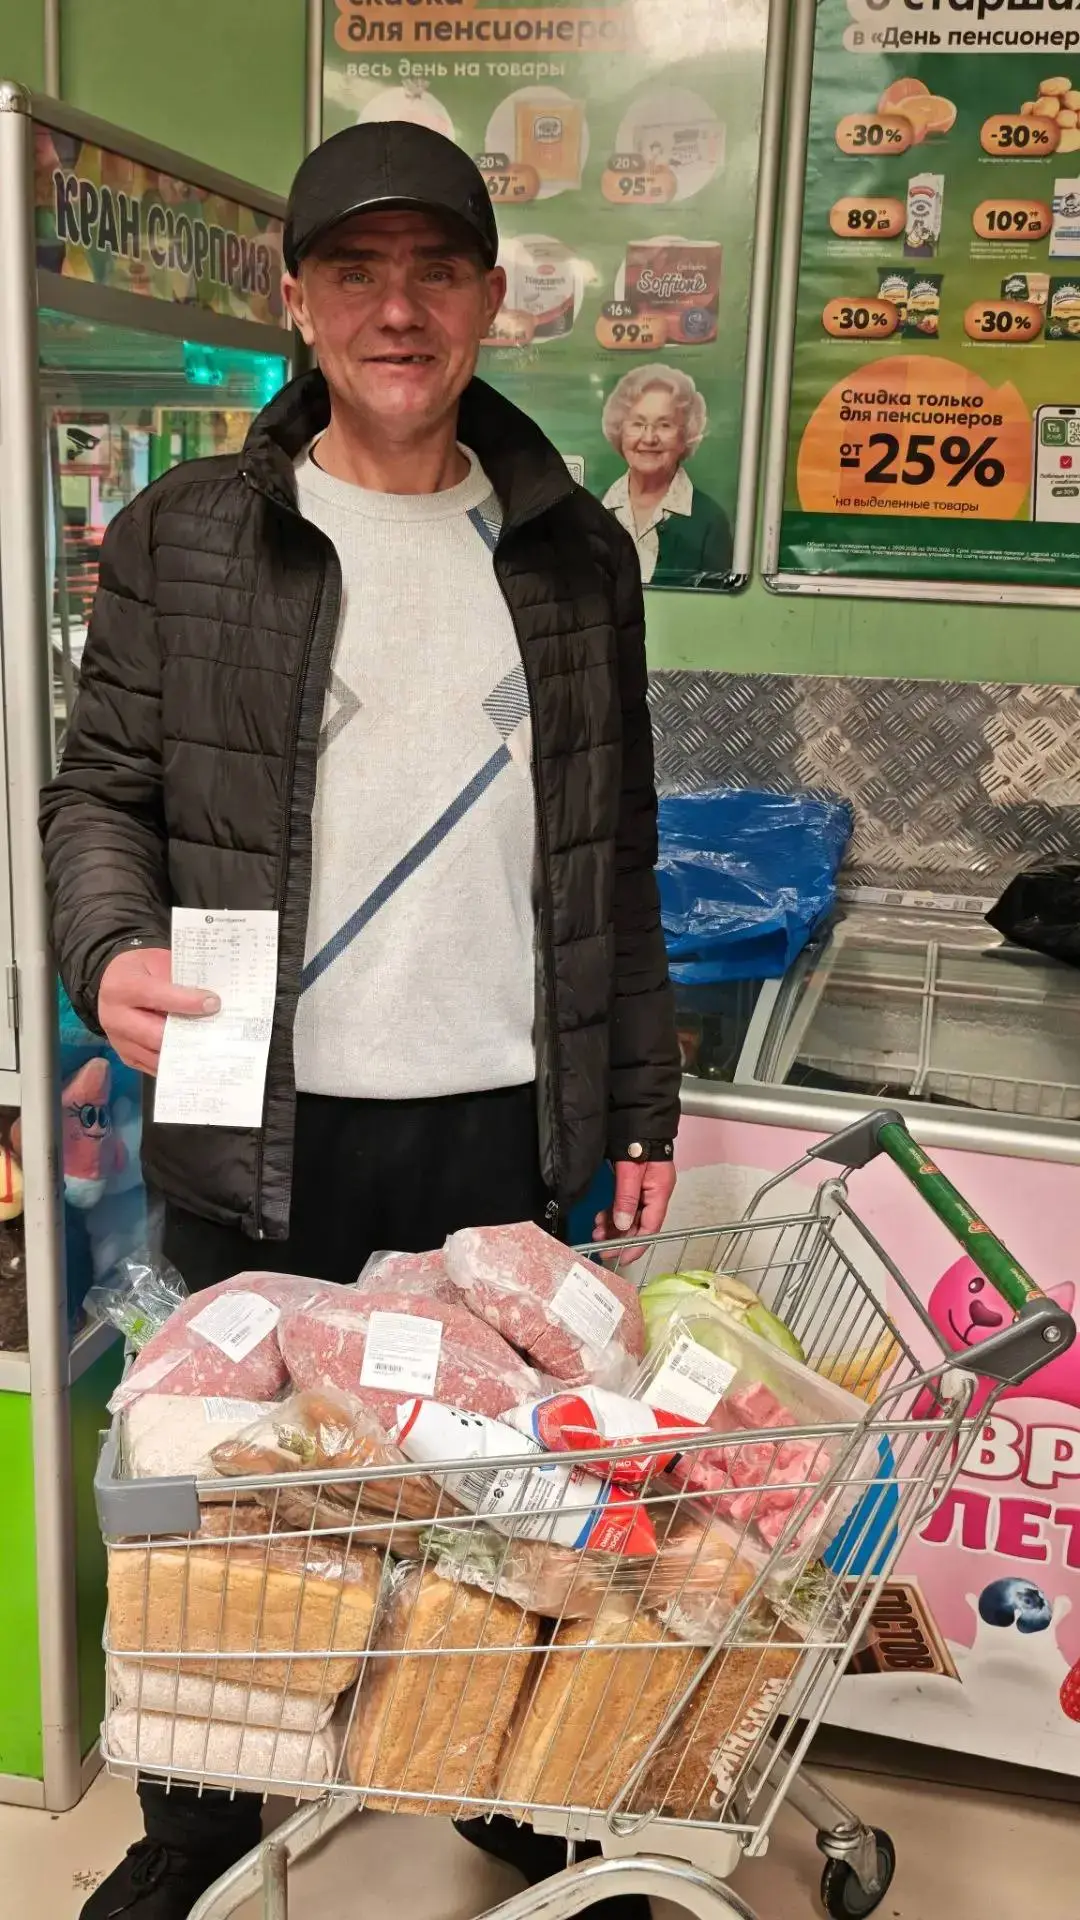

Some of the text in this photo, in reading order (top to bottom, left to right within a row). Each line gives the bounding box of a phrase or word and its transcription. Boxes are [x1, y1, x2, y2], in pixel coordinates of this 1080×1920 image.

[347, 15, 630, 47] для пенсионеро
[852, 26, 1080, 51] в «День пенсионер
[346, 58, 566, 79] весь день на товары
[845, 123, 903, 147] -30%
[990, 124, 1049, 148] -30%
[847, 209, 878, 230] 89
[985, 210, 1028, 231] 109
[53, 168, 272, 298] КРАН СЮРПРИЗ
[832, 307, 888, 330] -30%
[974, 310, 1032, 333] -30%
[840, 389, 984, 408] Скидка только
[839, 405, 1003, 429] для пенсионеров
[839, 443, 864, 457] от
[853, 496, 930, 510] выделенные
[933, 501, 979, 513] товары
